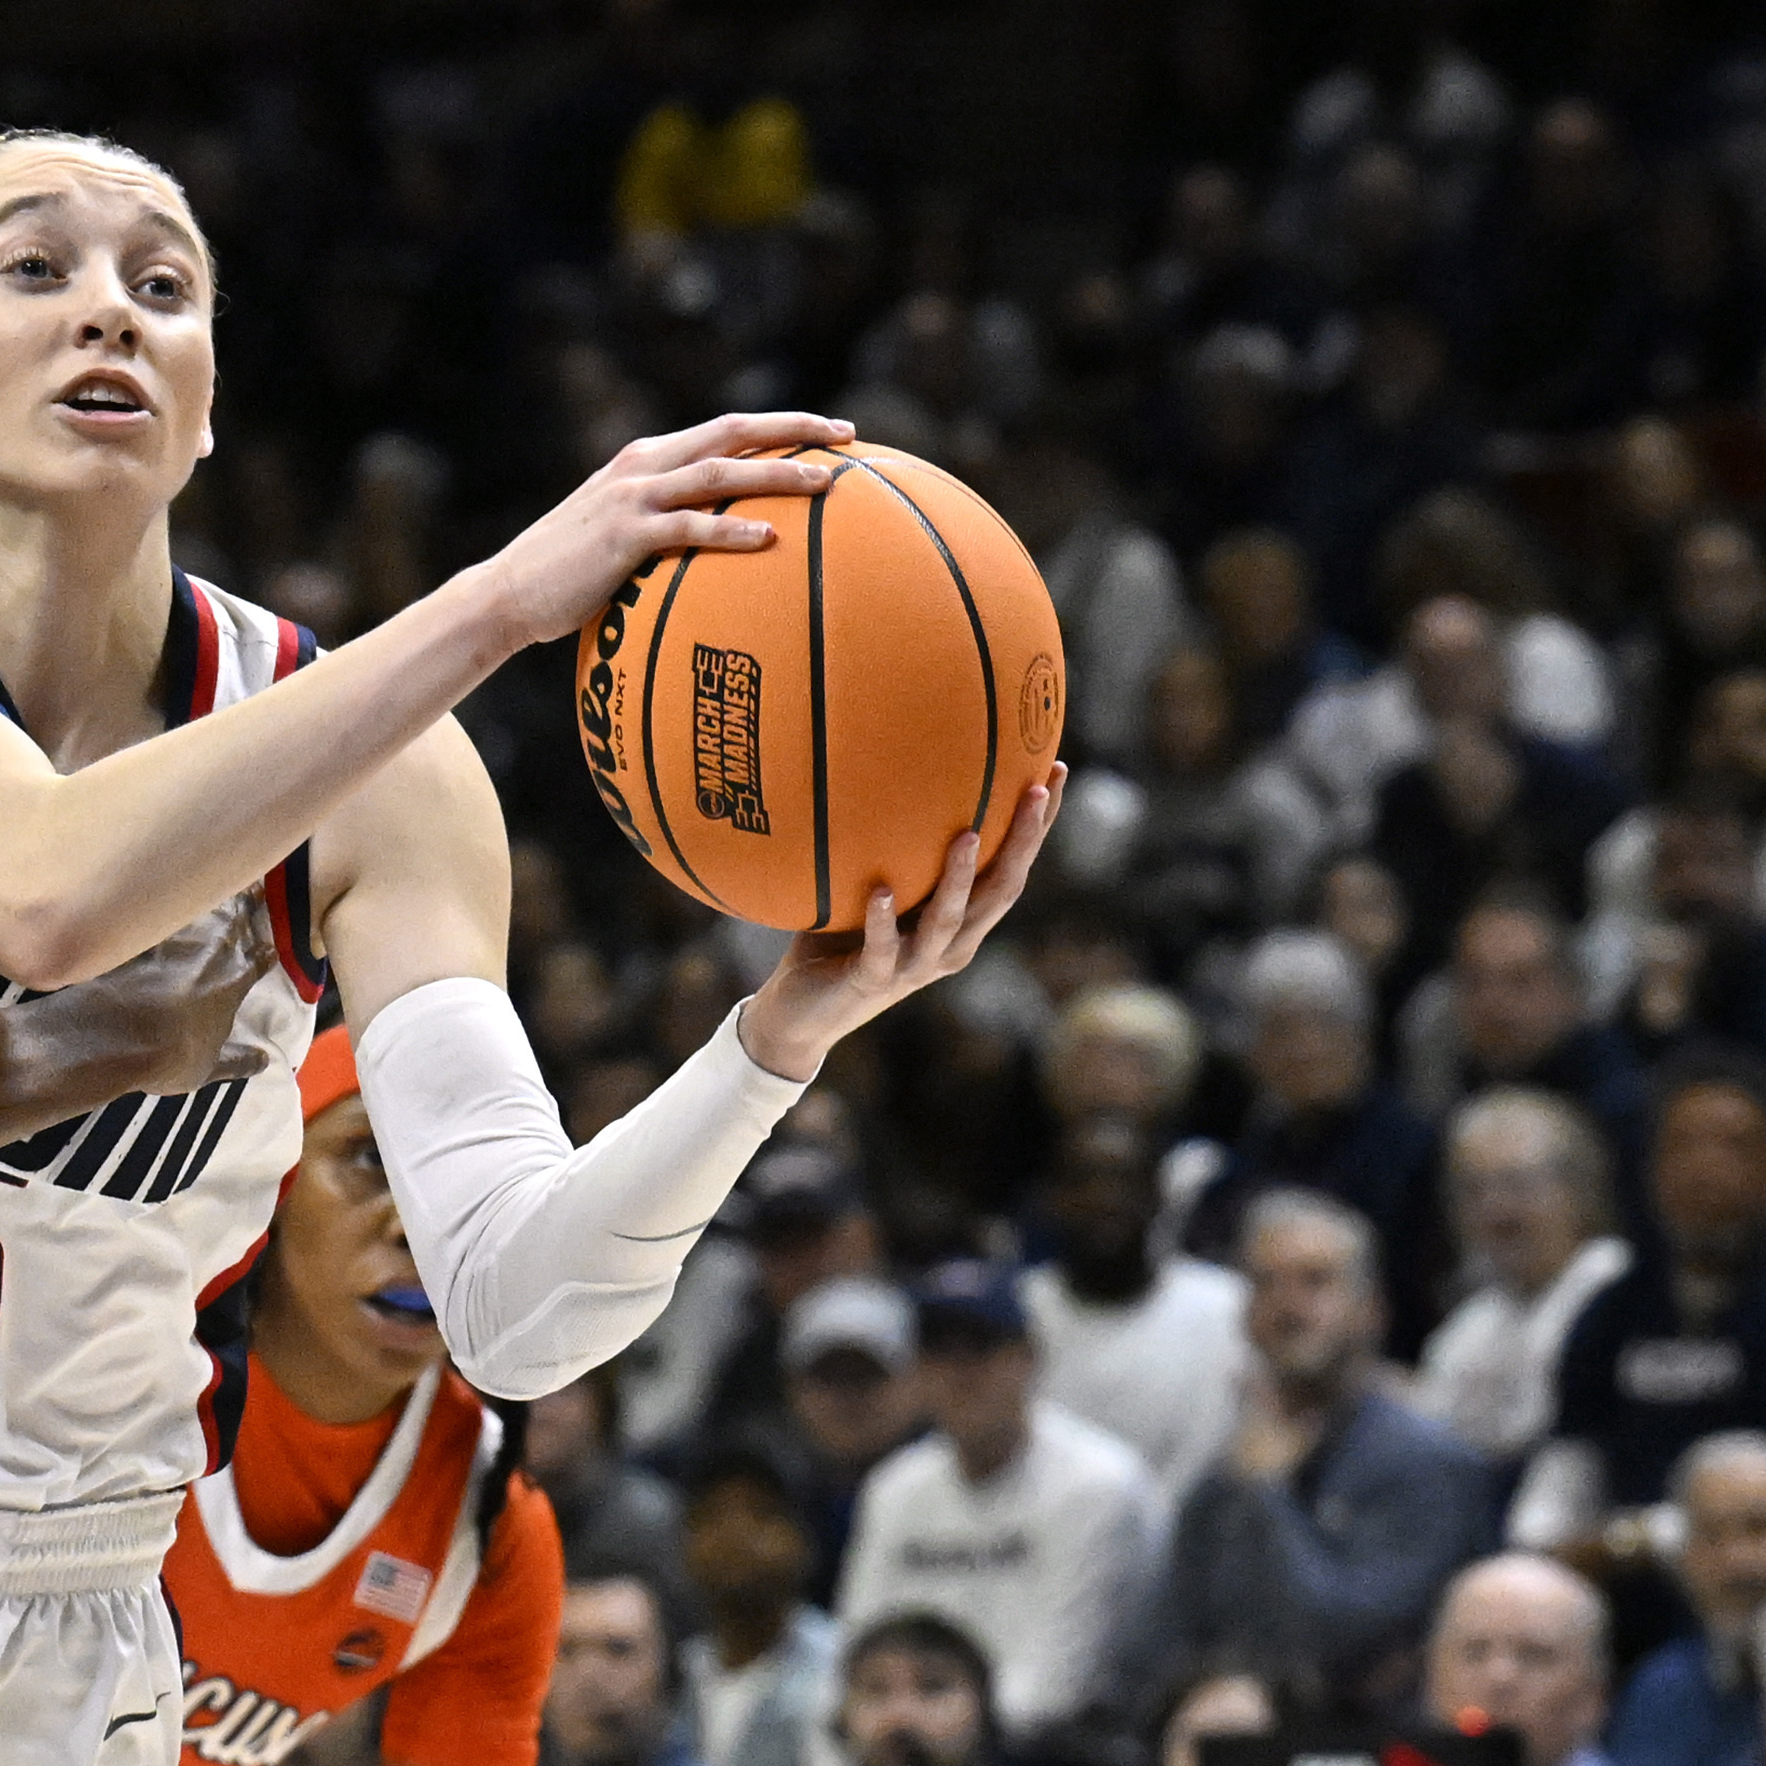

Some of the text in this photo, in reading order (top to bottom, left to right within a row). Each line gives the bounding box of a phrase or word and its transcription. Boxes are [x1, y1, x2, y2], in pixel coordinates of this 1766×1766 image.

[614, 667, 629, 772] EVO NXT
[697, 695, 724, 794] MARCH
[723, 652, 753, 785] MADNESS
